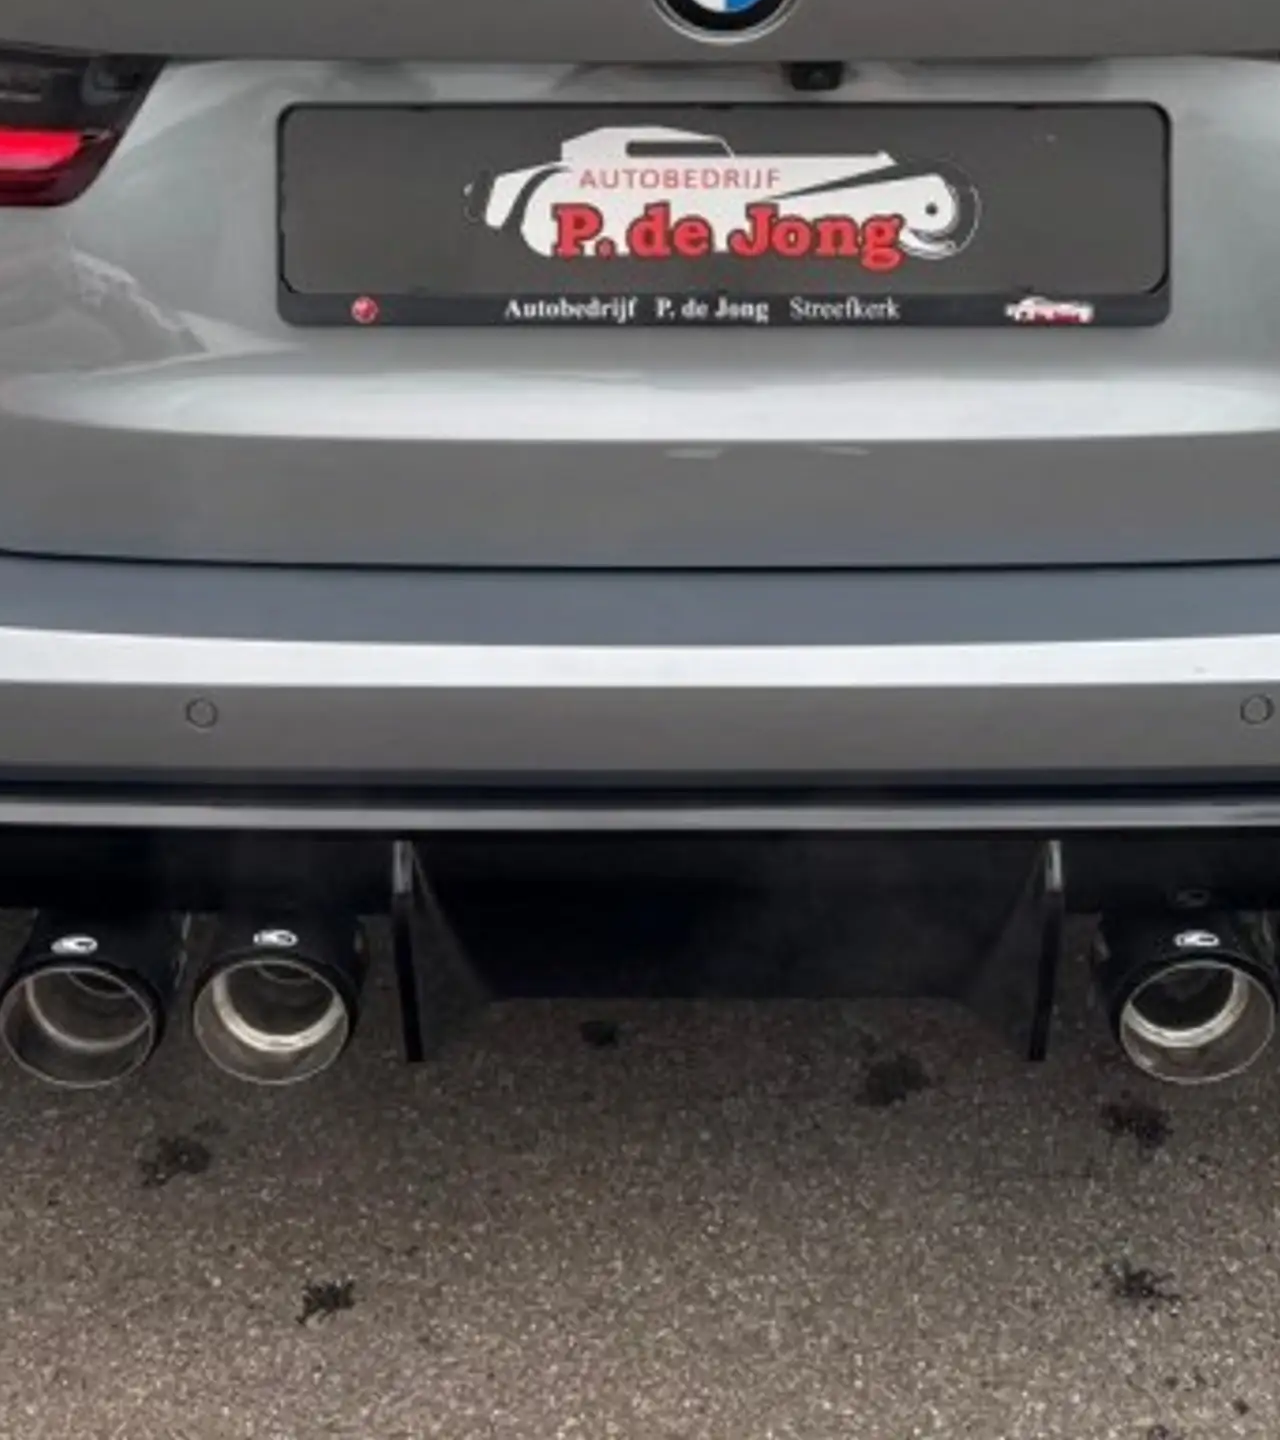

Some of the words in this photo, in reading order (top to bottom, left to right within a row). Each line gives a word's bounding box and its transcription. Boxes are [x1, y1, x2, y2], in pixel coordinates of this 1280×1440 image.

[579, 168, 782, 189] AUTOBEDRIJF
[551, 201, 615, 259] P.
[625, 197, 713, 260] de
[726, 201, 906, 272] Jong
[506, 296, 639, 324] Autobedrijf
[654, 296, 676, 319] P.
[681, 297, 709, 319] de
[714, 296, 770, 324] Jong
[789, 295, 901, 321] Streefkerk
